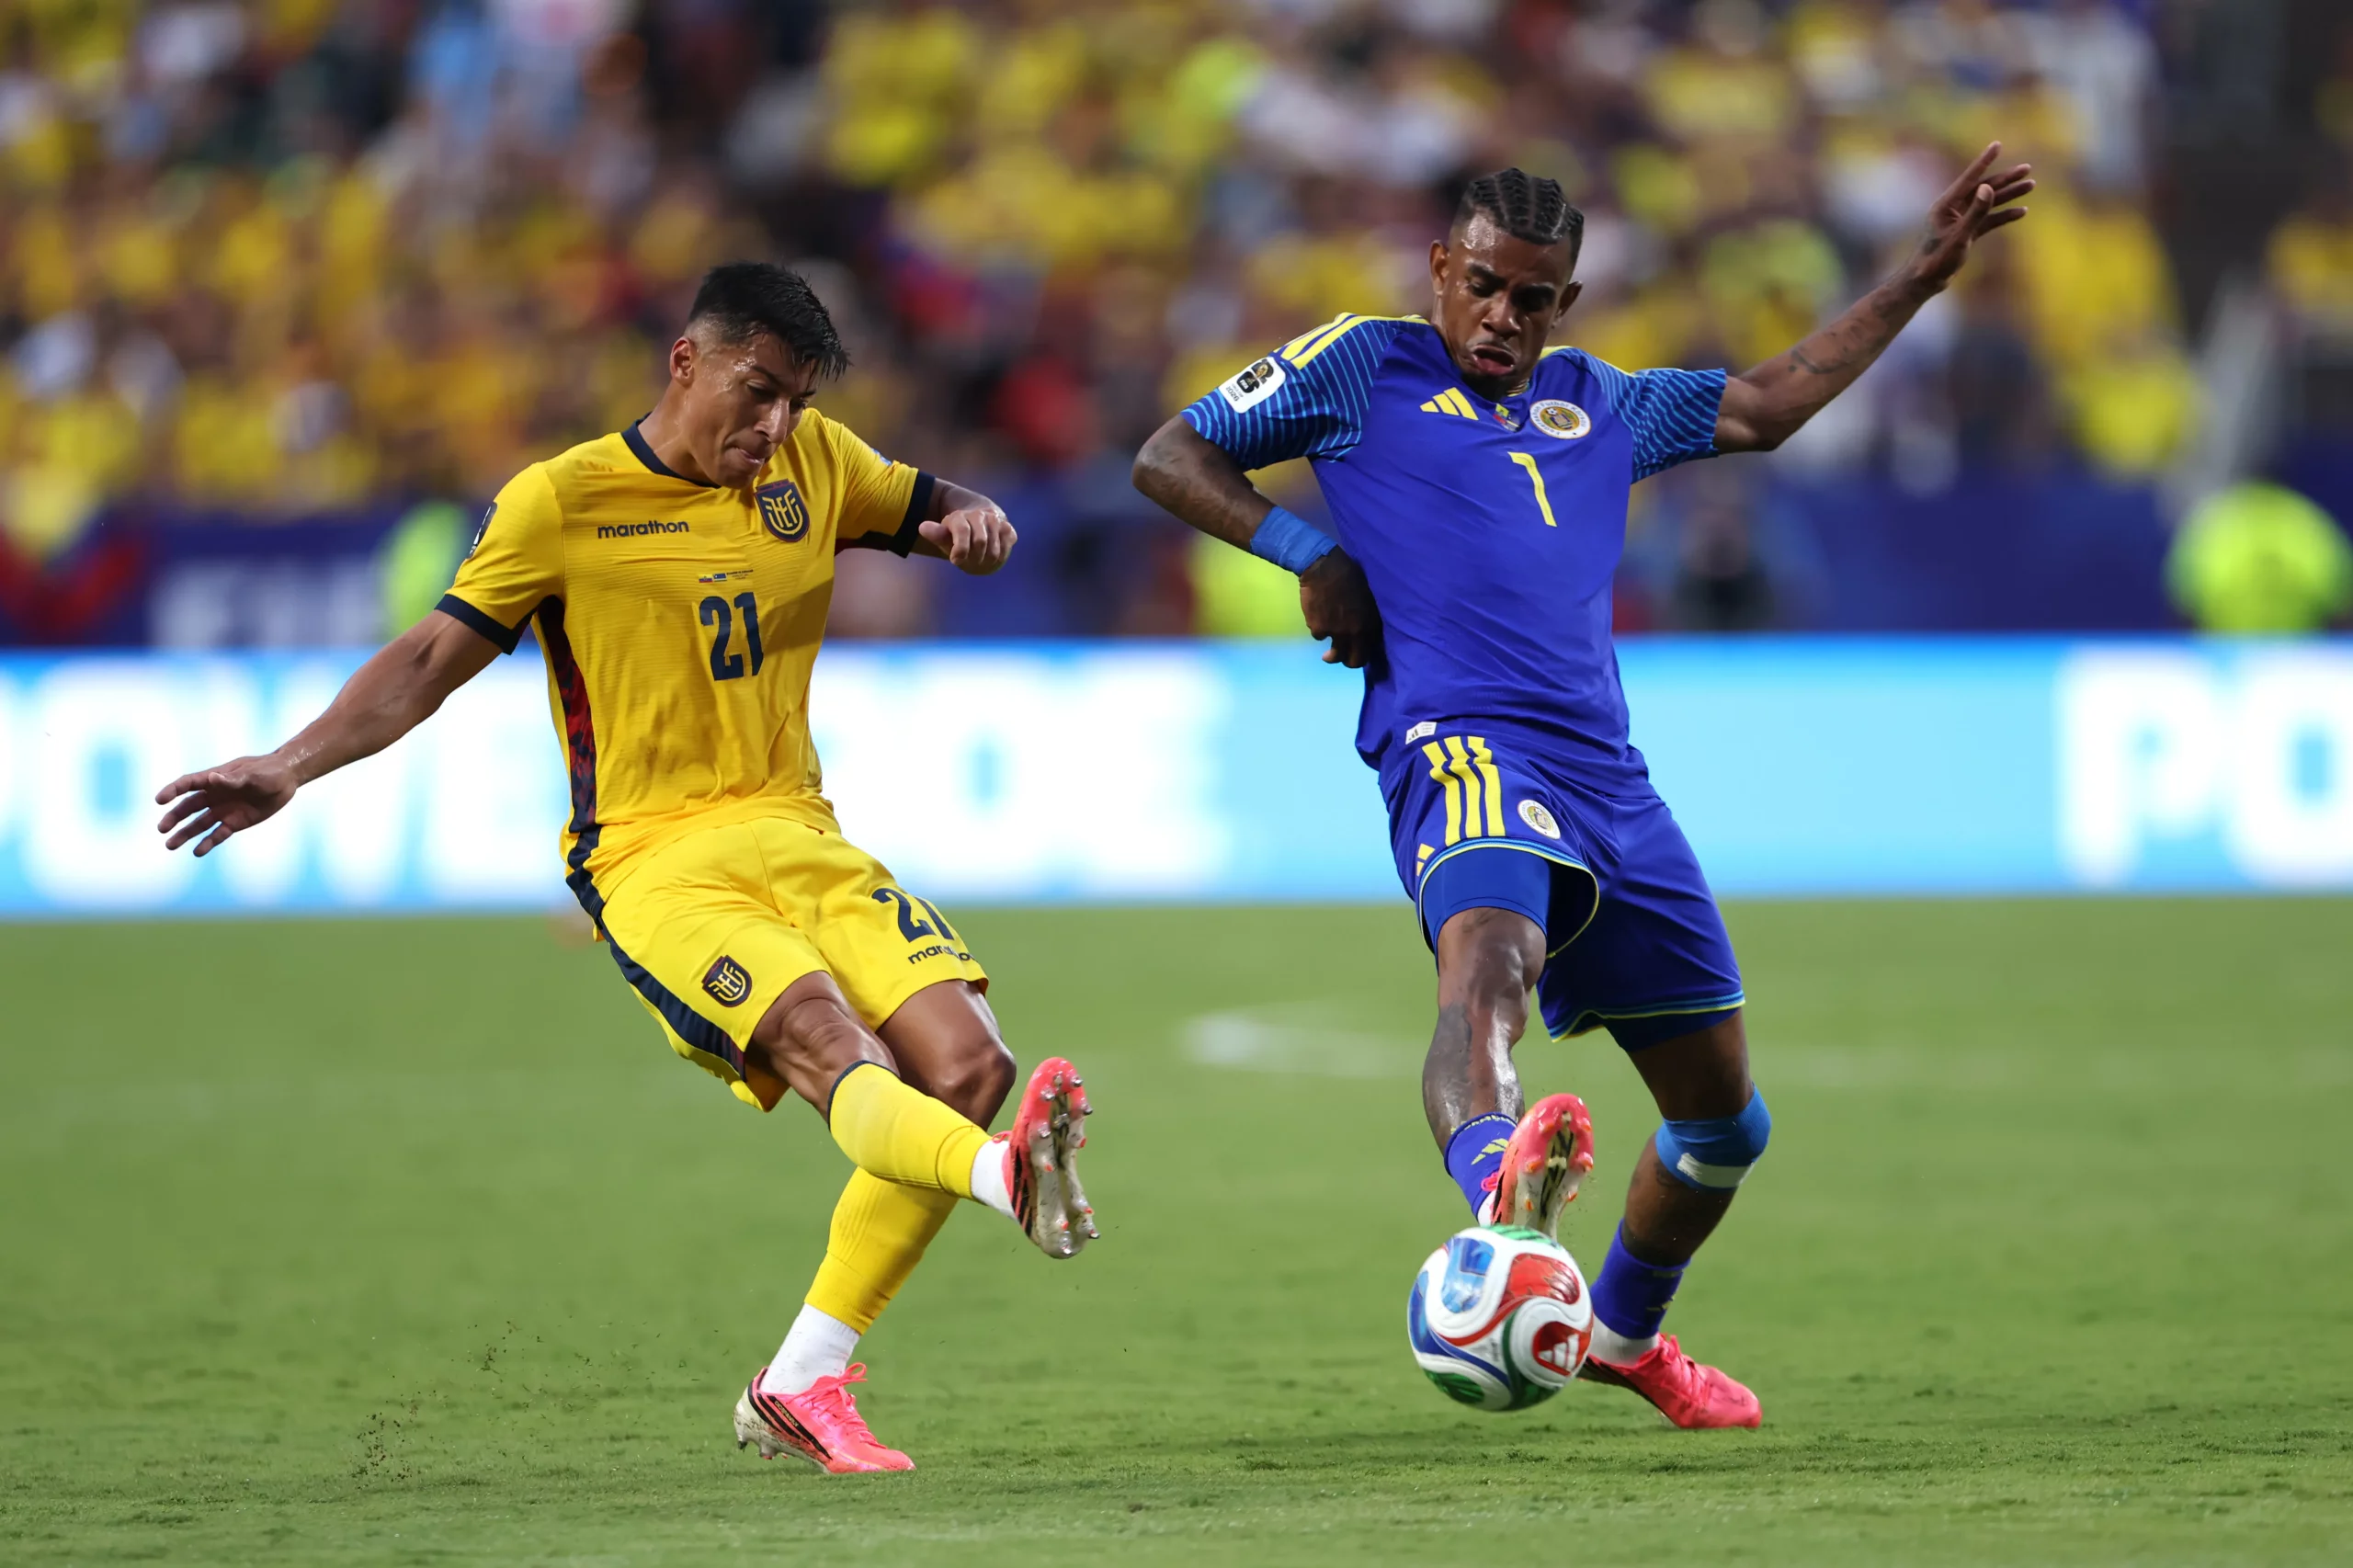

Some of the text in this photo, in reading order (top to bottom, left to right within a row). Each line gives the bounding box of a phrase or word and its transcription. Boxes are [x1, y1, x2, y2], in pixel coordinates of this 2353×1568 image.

[1507, 451, 1558, 528] 7
[597, 520, 689, 539] marathon
[699, 591, 764, 681] 21
[871, 888, 955, 943] 21
